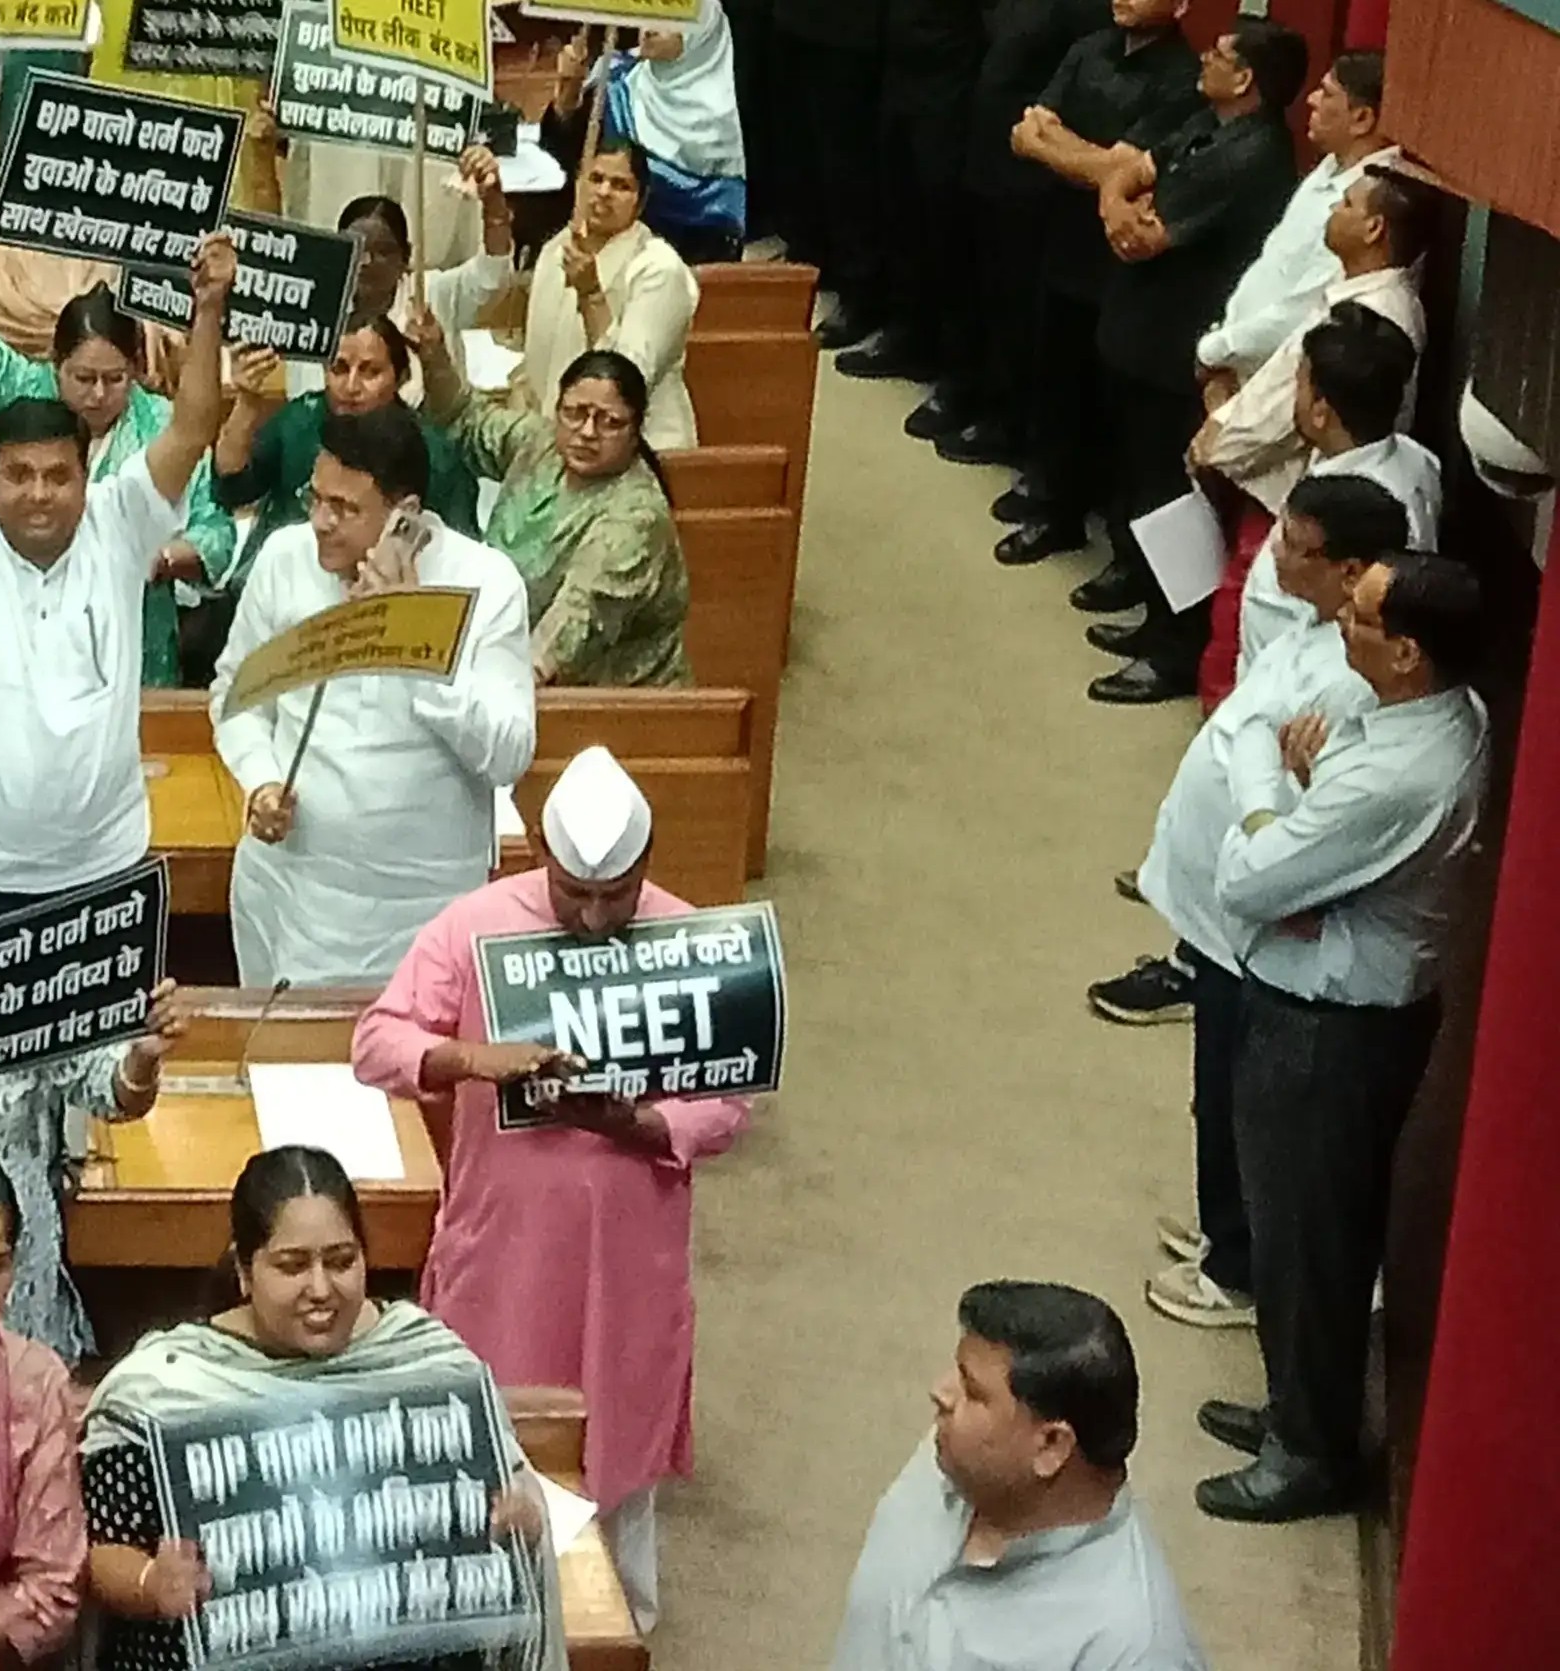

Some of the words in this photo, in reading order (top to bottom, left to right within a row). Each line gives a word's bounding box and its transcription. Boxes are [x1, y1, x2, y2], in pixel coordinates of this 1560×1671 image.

[37, 99, 80, 138] BJP
[138, 117, 184, 154] शर्म
[182, 123, 225, 162] करो
[0, 200, 50, 236] साथ
[95, 159, 120, 196] के
[190, 175, 214, 214] के
[39, 905, 91, 955] शर्म
[94, 889, 147, 937] करो
[0, 982, 28, 1016] के
[116, 944, 144, 978] के
[502, 950, 555, 990] BJP
[558, 936, 629, 980] वालो
[635, 927, 690, 973] शर्म
[691, 923, 752, 966] करो
[98, 988, 148, 1030] करो
[548, 976, 721, 1062] NEET
[703, 1046, 759, 1088] करो
